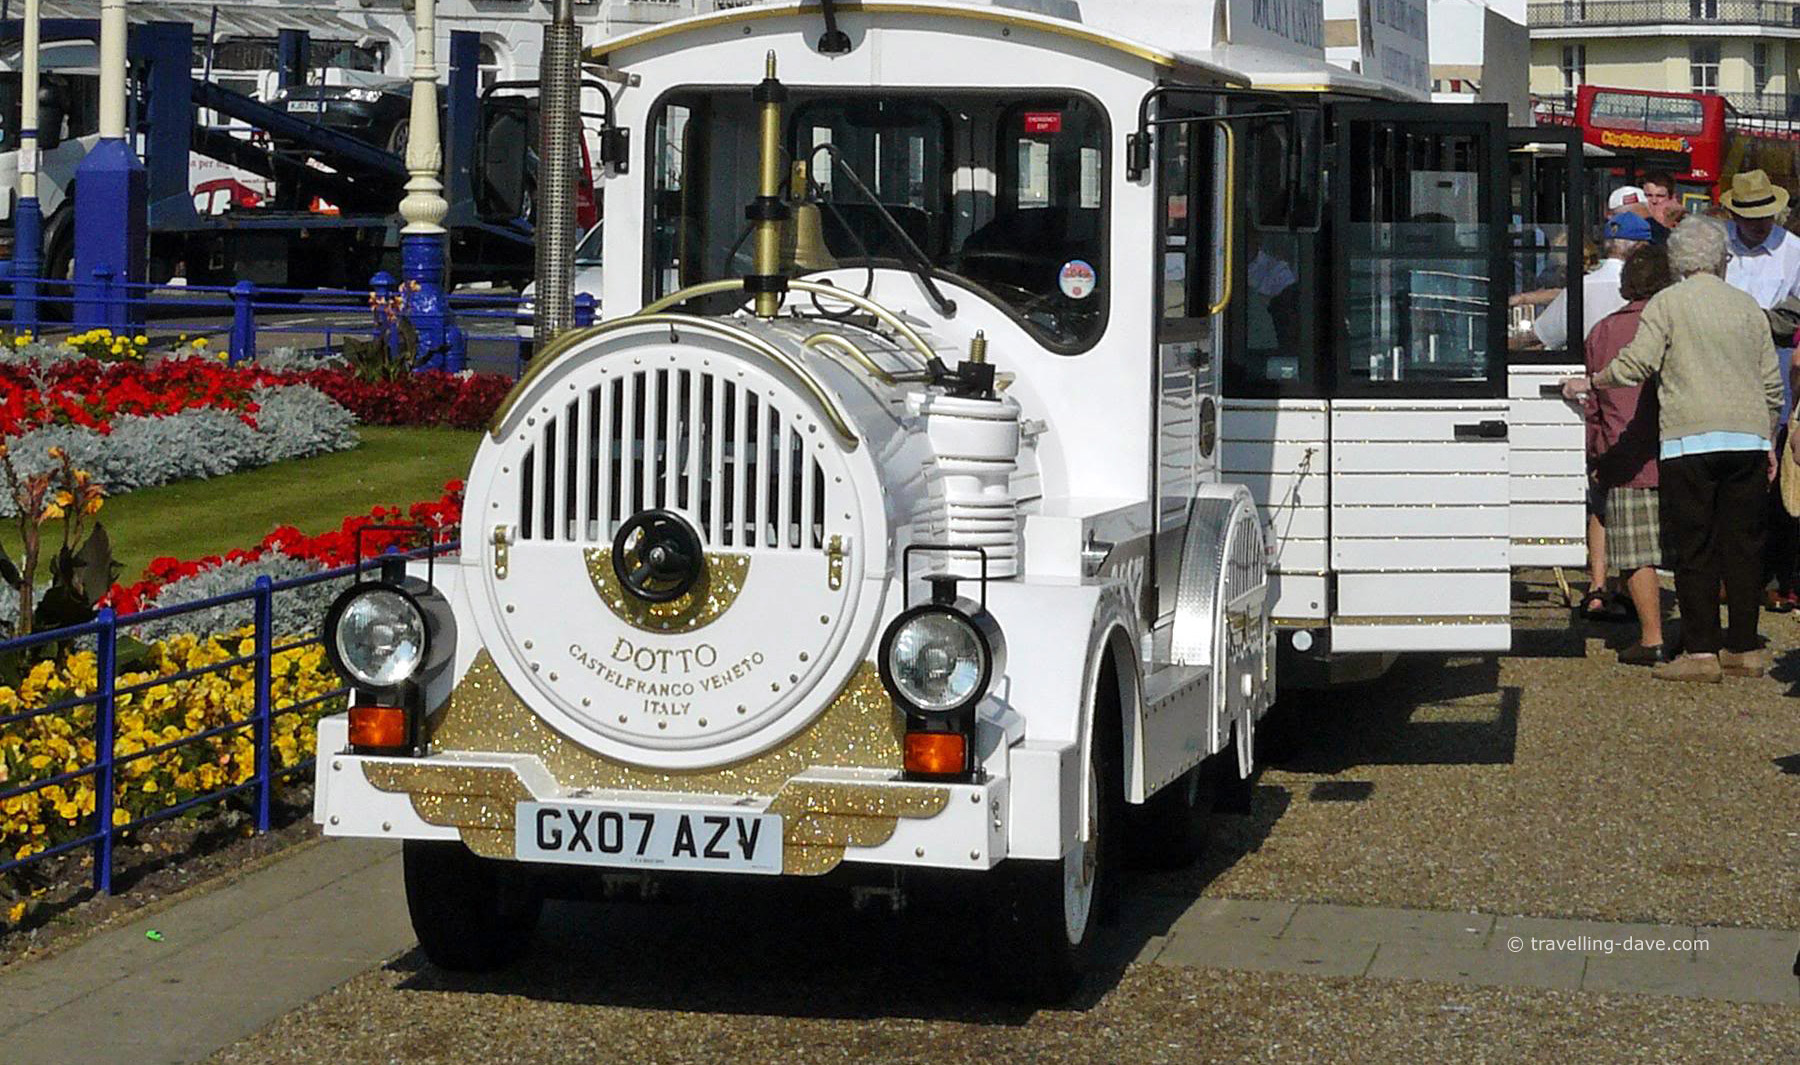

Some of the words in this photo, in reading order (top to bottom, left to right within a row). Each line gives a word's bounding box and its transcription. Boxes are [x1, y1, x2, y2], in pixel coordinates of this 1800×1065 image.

[569, 643, 694, 697] CASTELFRANCO
[699, 651, 764, 693] VENETO
[611, 636, 717, 674] DOTTO
[643, 699, 691, 716] ITALY
[536, 808, 655, 856] GX07
[672, 814, 762, 861] AZV
